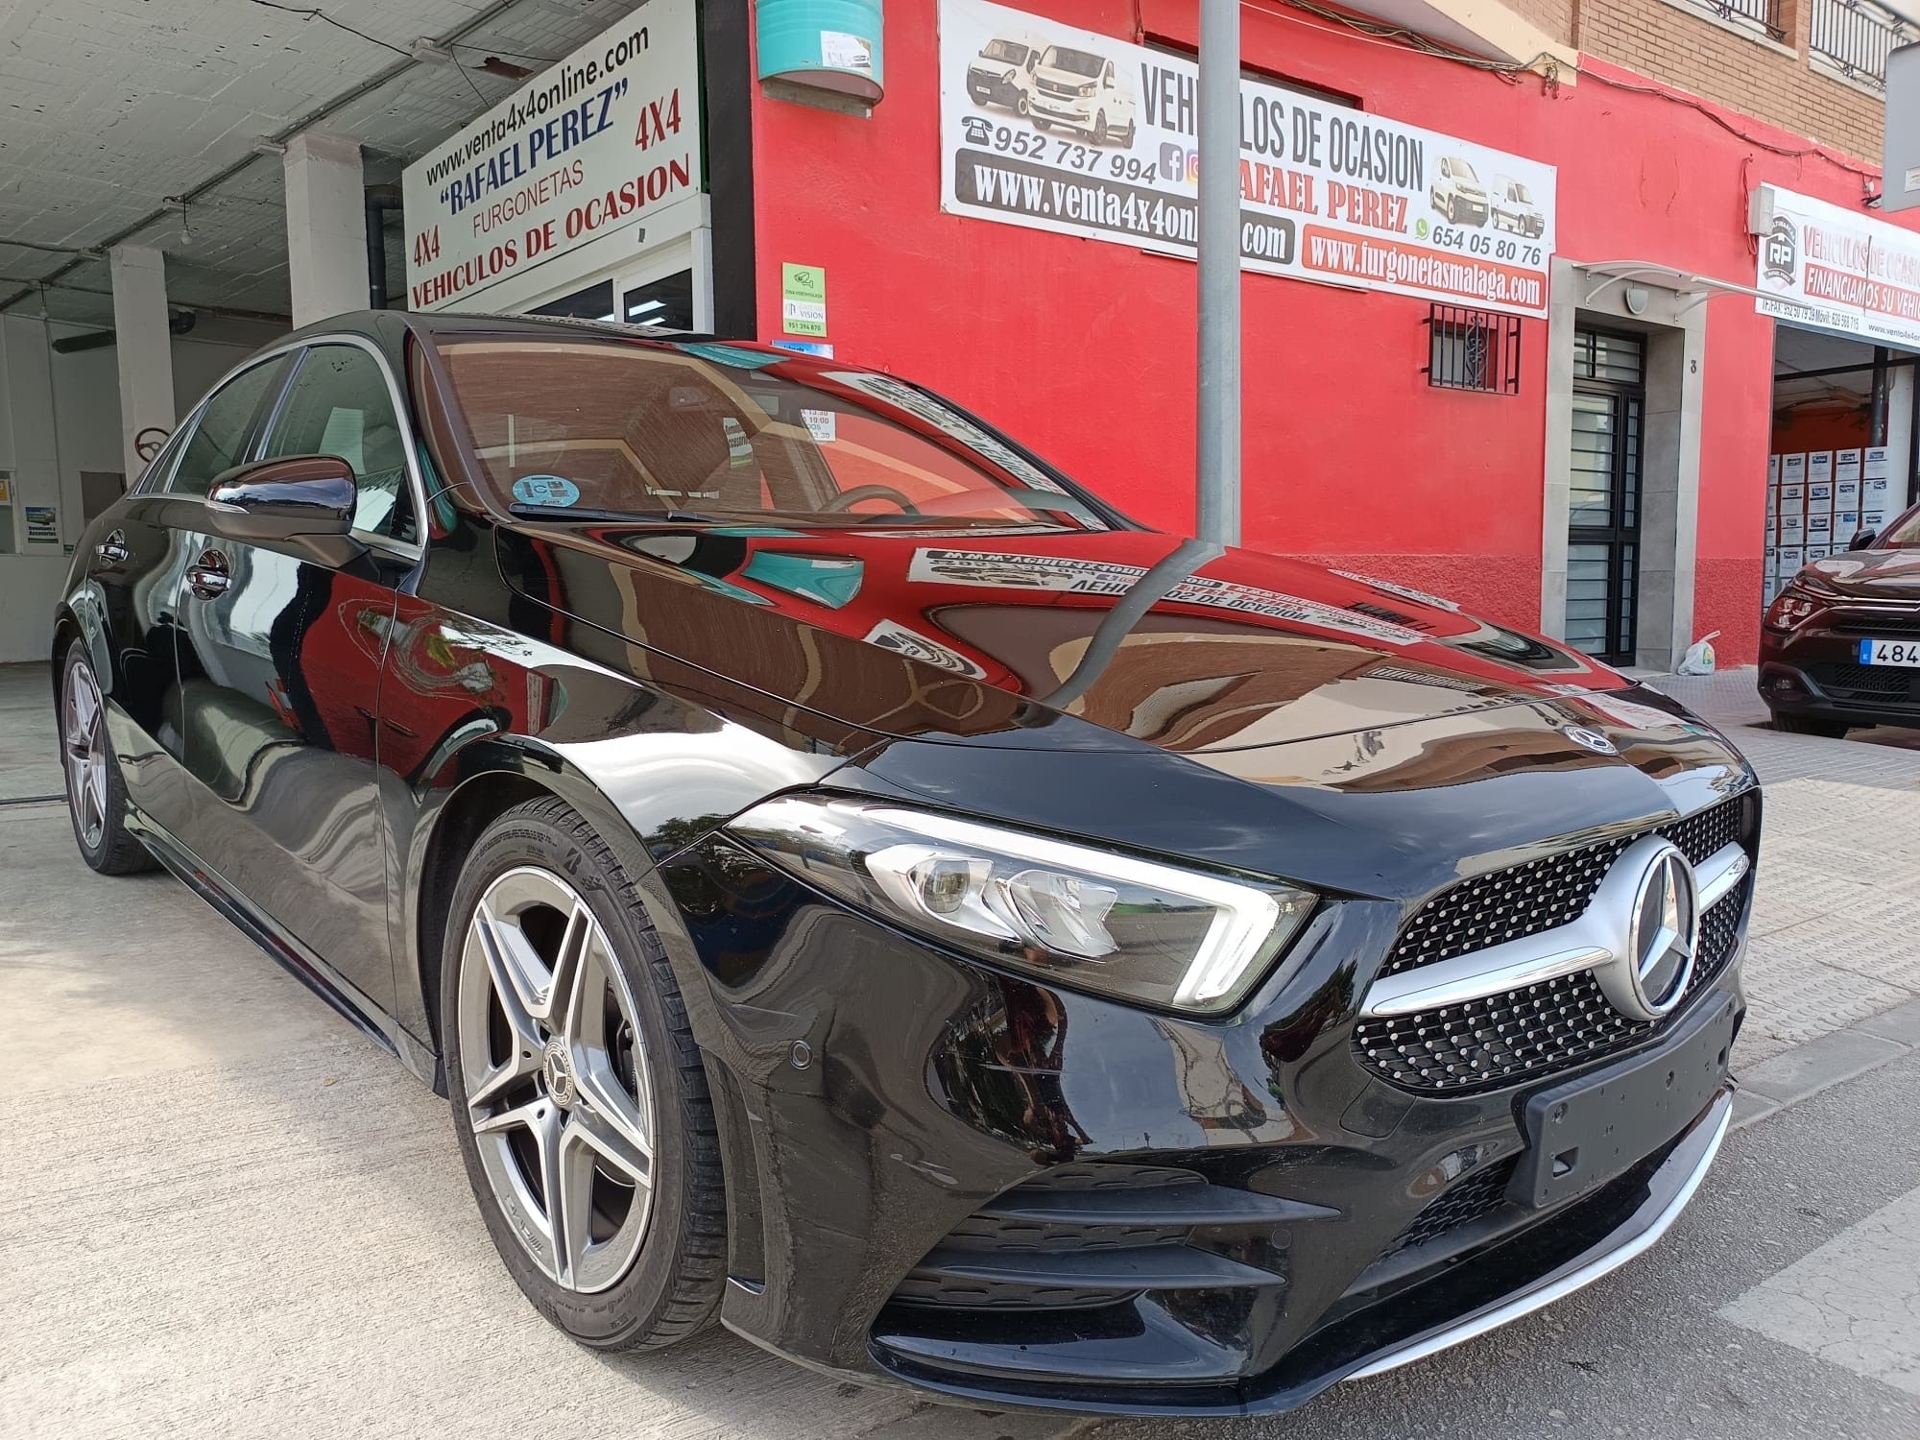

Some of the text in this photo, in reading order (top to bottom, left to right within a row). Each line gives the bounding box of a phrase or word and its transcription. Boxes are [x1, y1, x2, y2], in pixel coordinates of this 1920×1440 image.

[426, 26, 649, 186] www.venta4x4online.com
[634, 88, 681, 151] 4X4
[993, 126, 1157, 185] 952 737 994
[1292, 106, 1322, 169] DE
[1329, 116, 1423, 192] OCASION
[473, 159, 584, 238] FURGONETAS
[1239, 158, 1408, 234] AFAEL PEREZ
[412, 153, 690, 309] VEHICULOS DE OCASION
[413, 224, 440, 267] 4X4
[1432, 225, 1541, 266] 654 05 80 76
[1769, 242, 1791, 265] RP
[1804, 225, 1867, 272] VEHICULOS
[1870, 246, 1884, 277] DE
[1310, 233, 1541, 306] www.furgonetasmalaga.com
[1806, 267, 1879, 308] FINANCIAMOS
[1881, 286, 1895, 312] SU
[800, 310, 823, 320] VISION
[1690, 360, 1697, 374] 3
